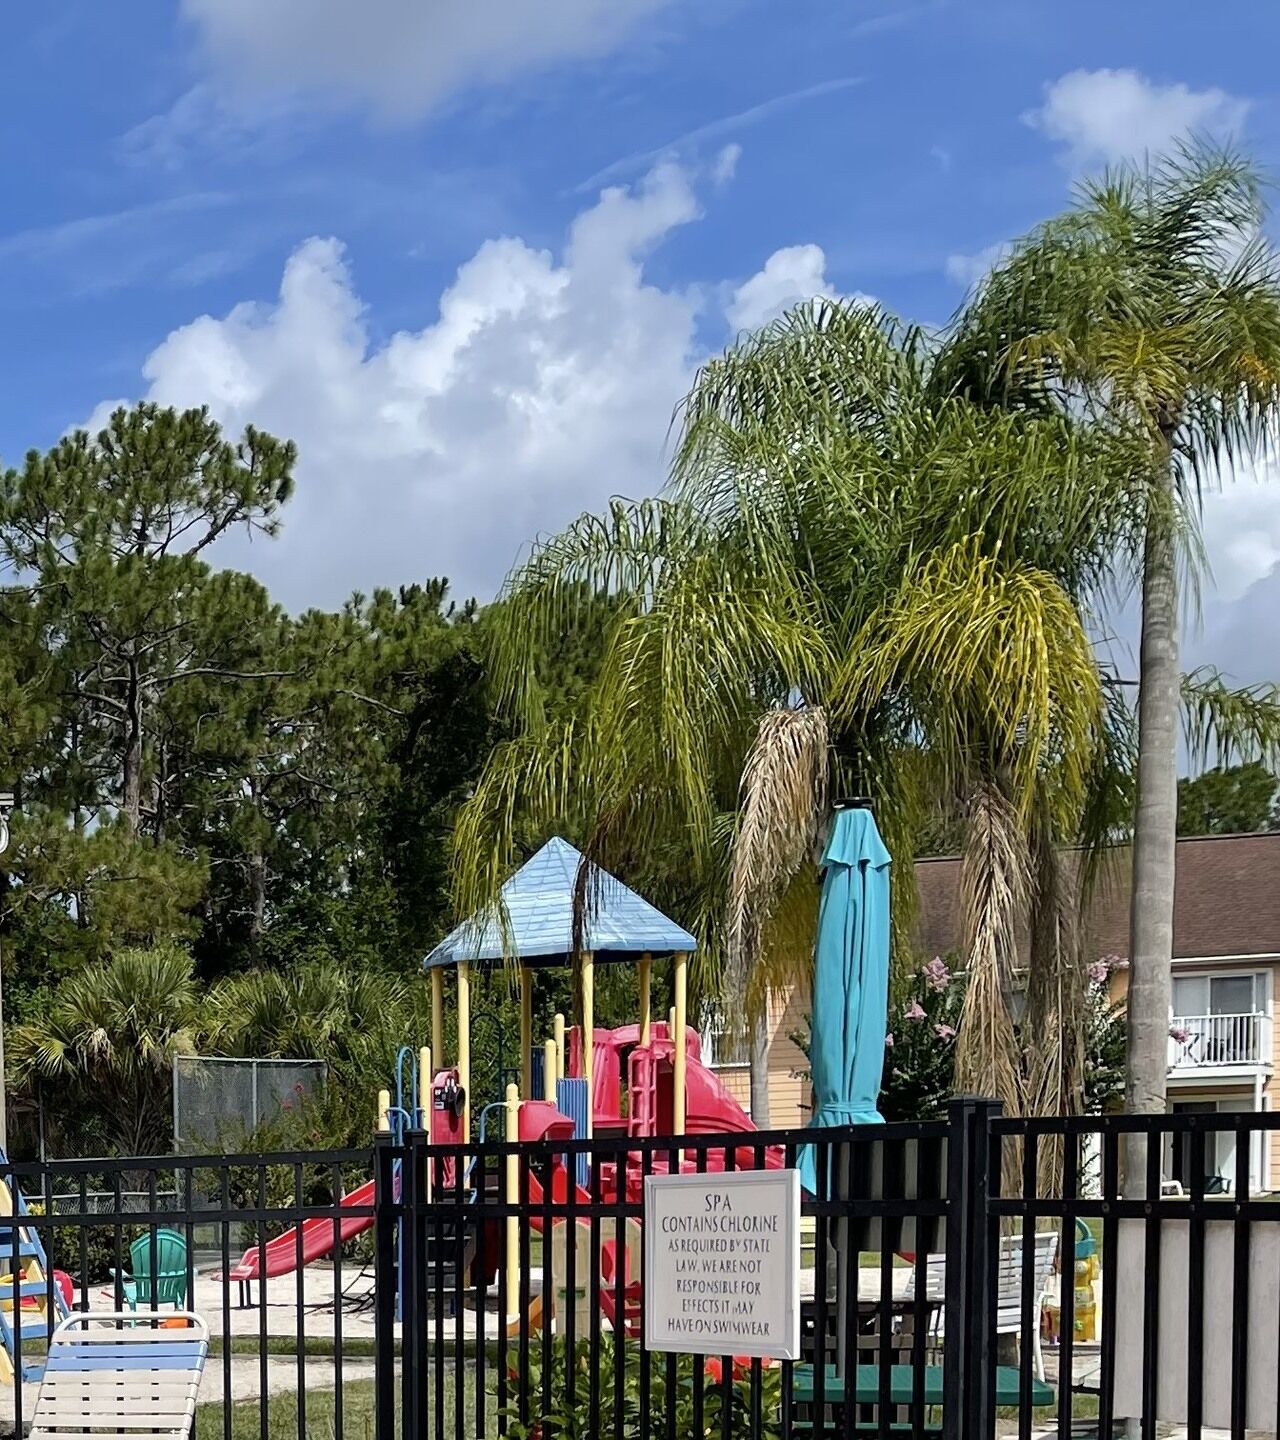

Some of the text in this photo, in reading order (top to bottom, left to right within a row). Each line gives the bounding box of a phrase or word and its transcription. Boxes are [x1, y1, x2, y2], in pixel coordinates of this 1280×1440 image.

[705, 1194, 732, 1212] SPA
[662, 1215, 778, 1233] CONTAINS CHLORINE
[669, 1239, 679, 1252] AS
[681, 1239, 727, 1255] REQUIRED
[730, 1240, 741, 1252] BY
[703, 1260, 717, 1273] WE
[720, 1260, 737, 1273] ARE
[740, 1260, 761, 1273] NOT
[677, 1280, 761, 1296] RESPONSIBLE FOR
[682, 1299, 719, 1313] EFFECTS
[722, 1301, 729, 1314] IT
[668, 1320, 770, 1336] HAVE ON SWIMWEAR
